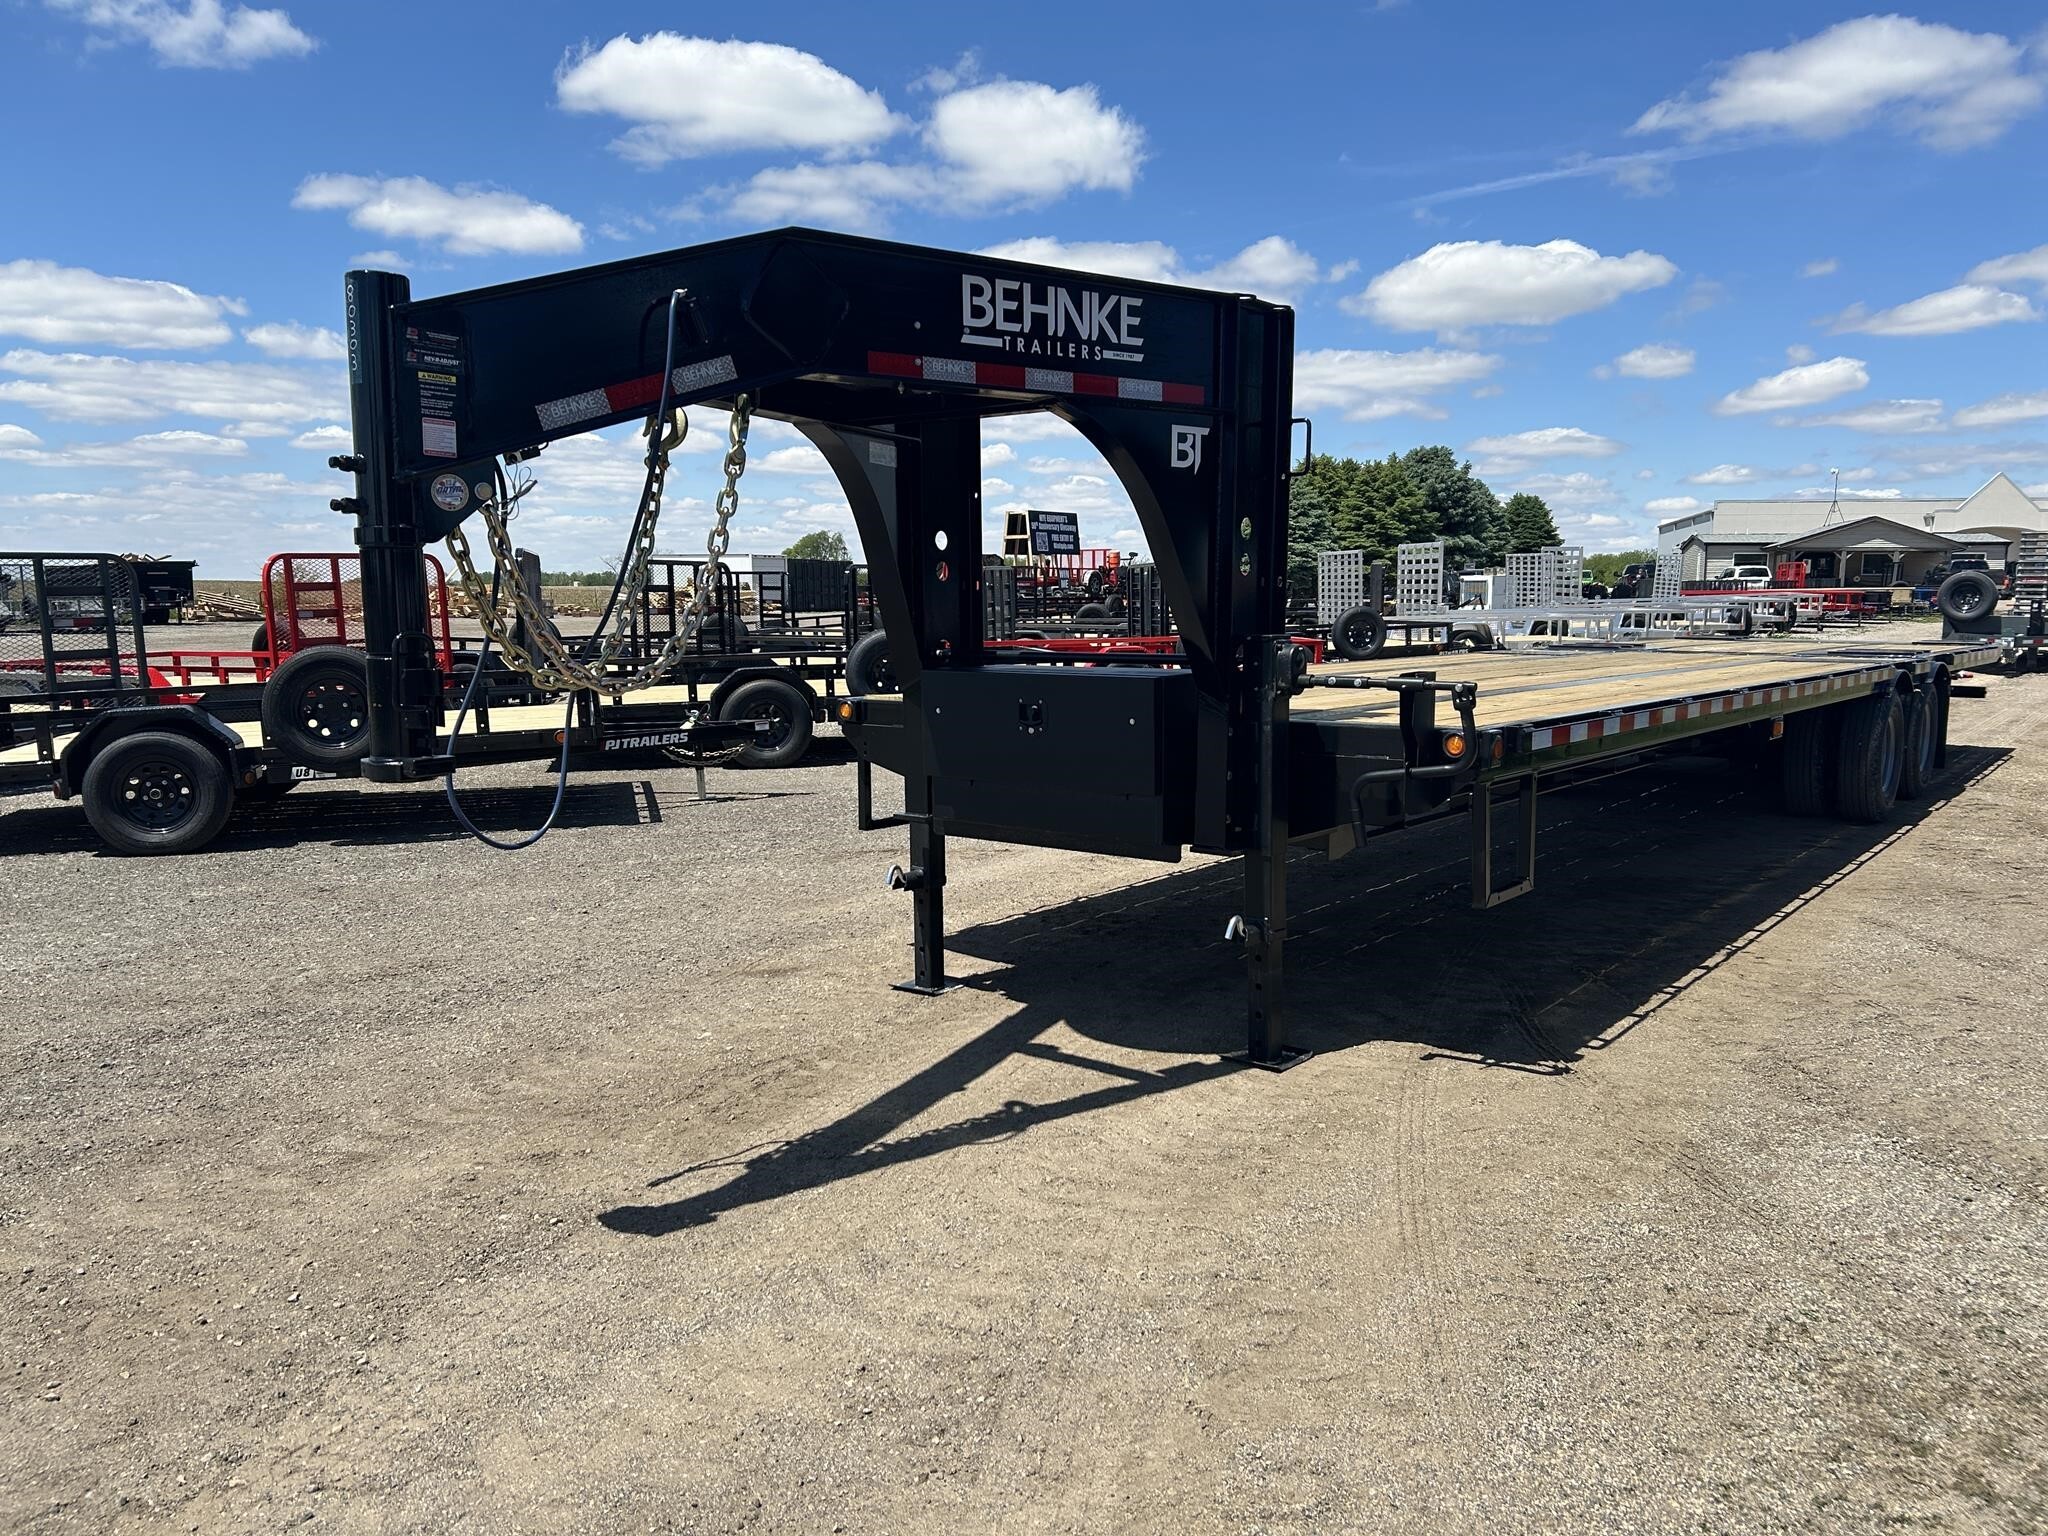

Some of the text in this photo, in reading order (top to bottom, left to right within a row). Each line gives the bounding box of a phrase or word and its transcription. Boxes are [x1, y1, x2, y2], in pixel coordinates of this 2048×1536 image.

[962, 273, 1145, 347] BEHNKE
[346, 284, 358, 371] 80303
[1004, 335, 1101, 361] TRAILERS
[427, 373, 453, 382] WARNING
[683, 363, 725, 382] BEHNKE
[932, 361, 967, 375] BEHNKE
[1034, 372, 1066, 384] BEHNKE
[550, 397, 597, 418] BEHNKE
[1171, 424, 1210, 475] BT
